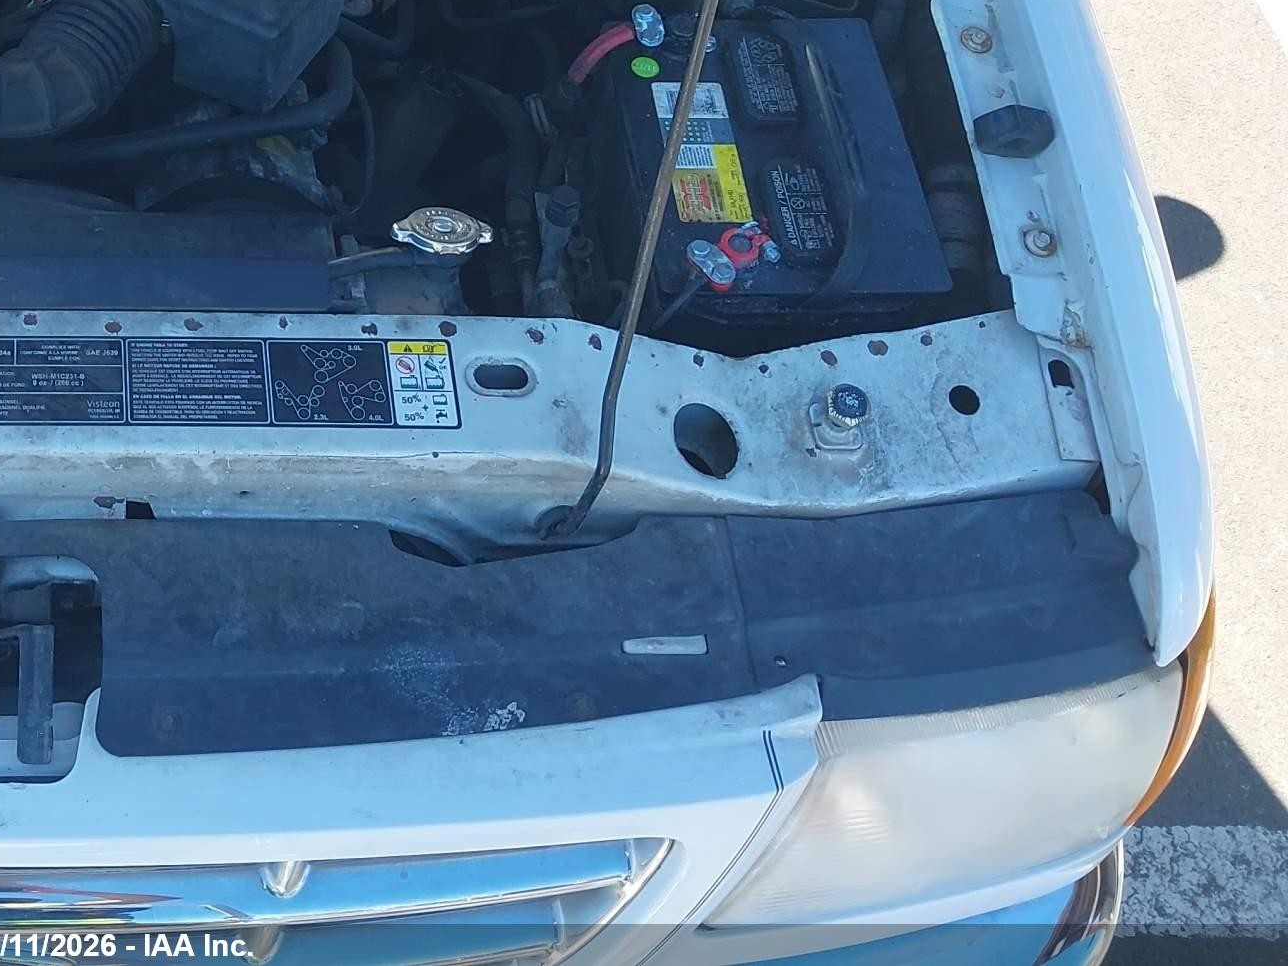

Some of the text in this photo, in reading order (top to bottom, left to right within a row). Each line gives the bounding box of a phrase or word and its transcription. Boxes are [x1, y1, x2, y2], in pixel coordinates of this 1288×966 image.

[770, 170, 785, 199] POISON
[780, 206, 796, 239] DANGER
[86, 400, 120, 408] Visteon
[401, 395, 422, 404] 50%
[404, 412, 425, 422] 50%
